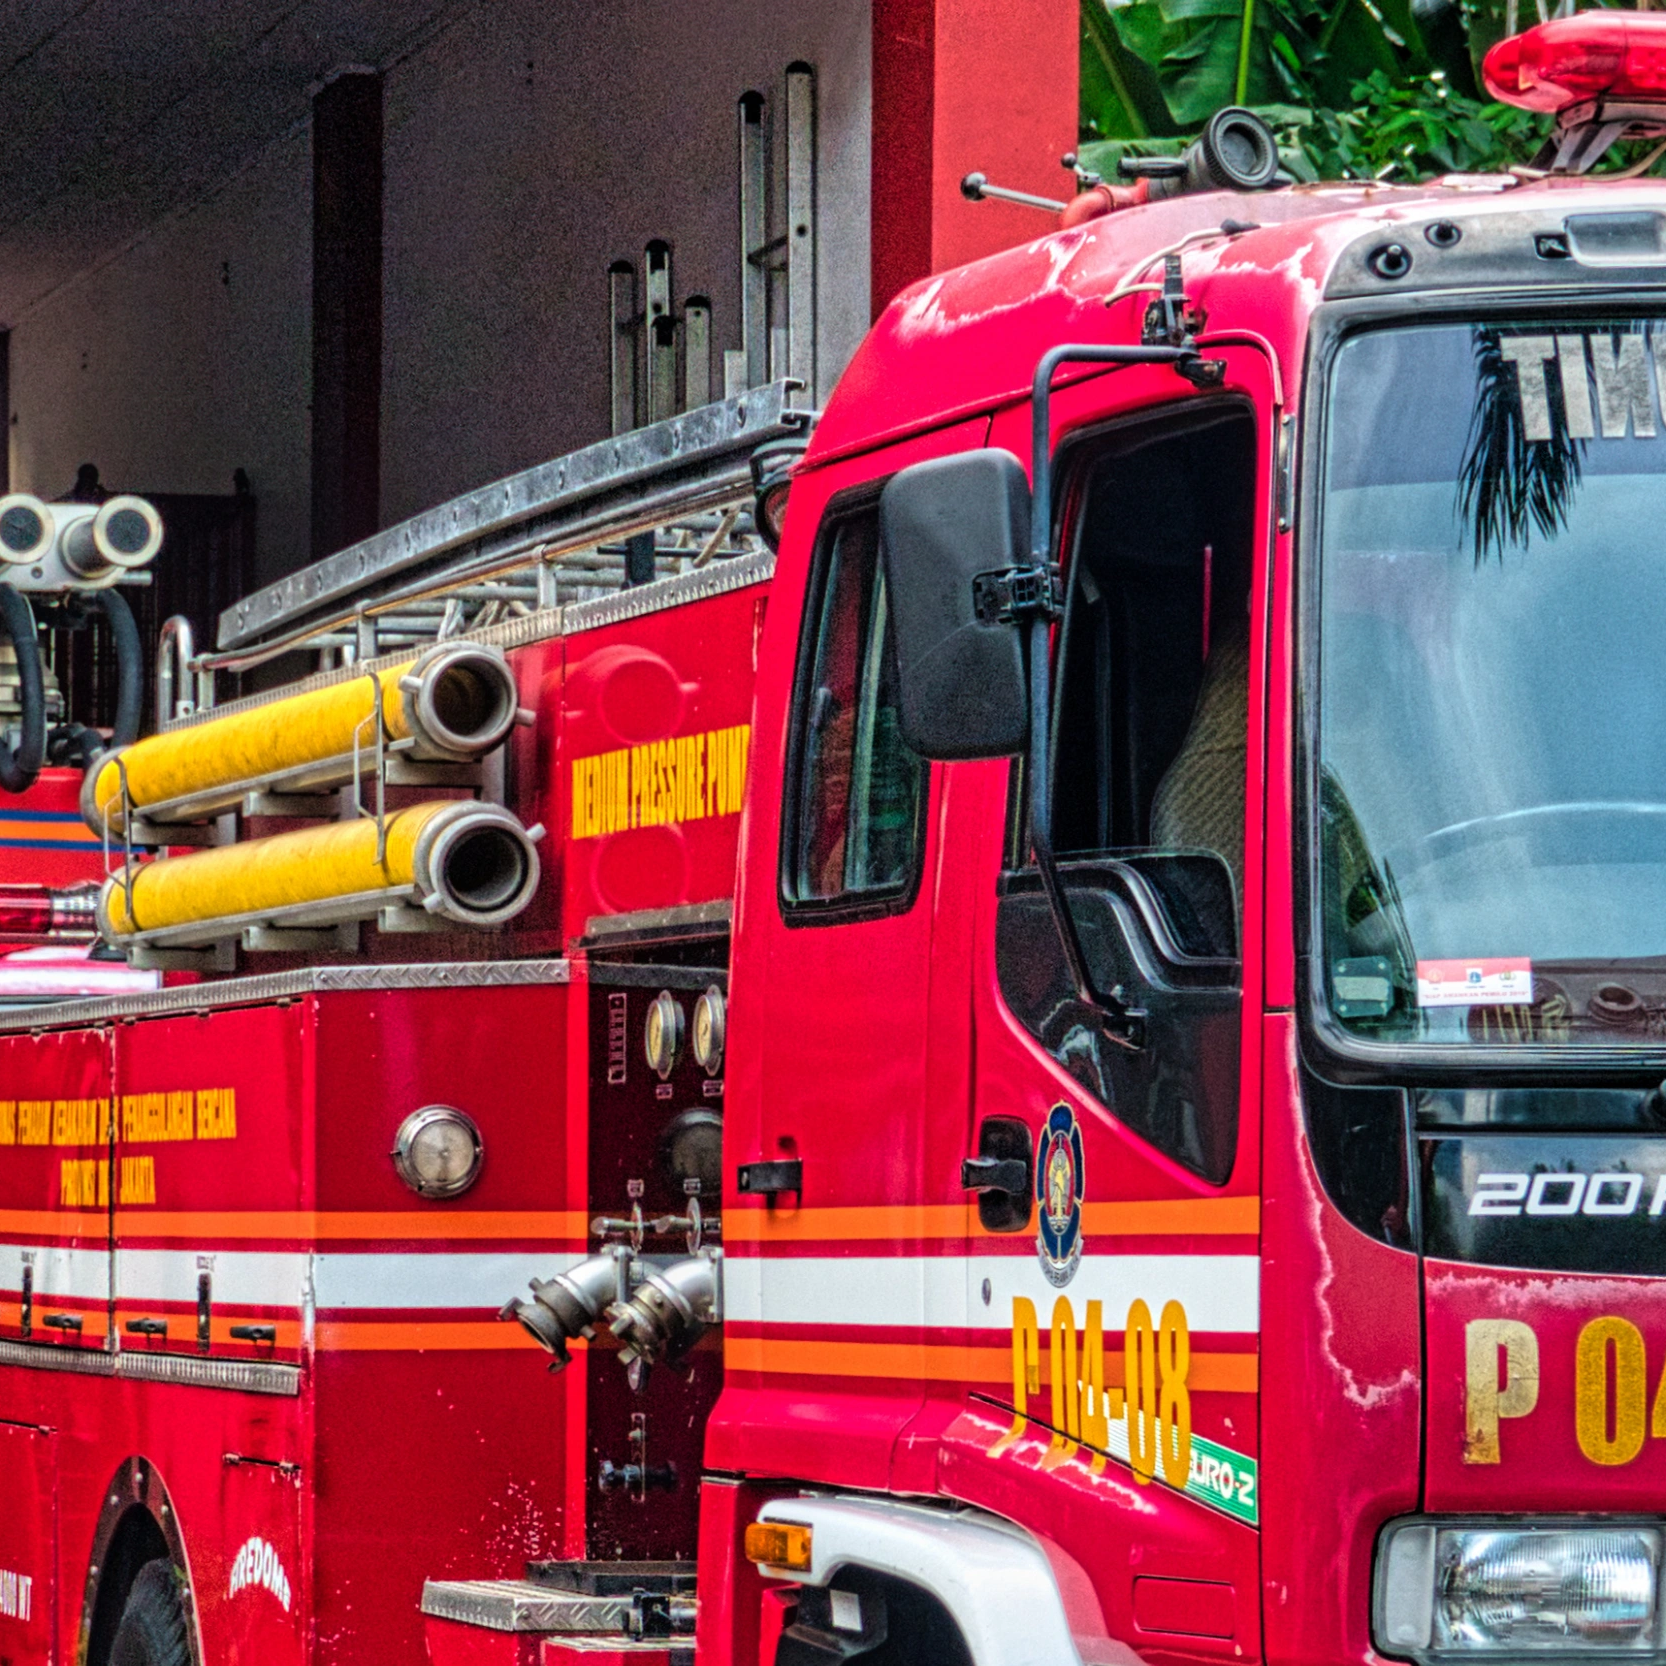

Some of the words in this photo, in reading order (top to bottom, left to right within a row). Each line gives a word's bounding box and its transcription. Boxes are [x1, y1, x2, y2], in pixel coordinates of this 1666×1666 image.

[571, 748, 629, 840] MEDIUM
[631, 733, 705, 829] PRESSURE
[1467, 1172, 1644, 1216] 200
[986, 1295, 1040, 1459] P
[1039, 1294, 1192, 1489] 04-08
[1462, 1318, 1540, 1465] P
